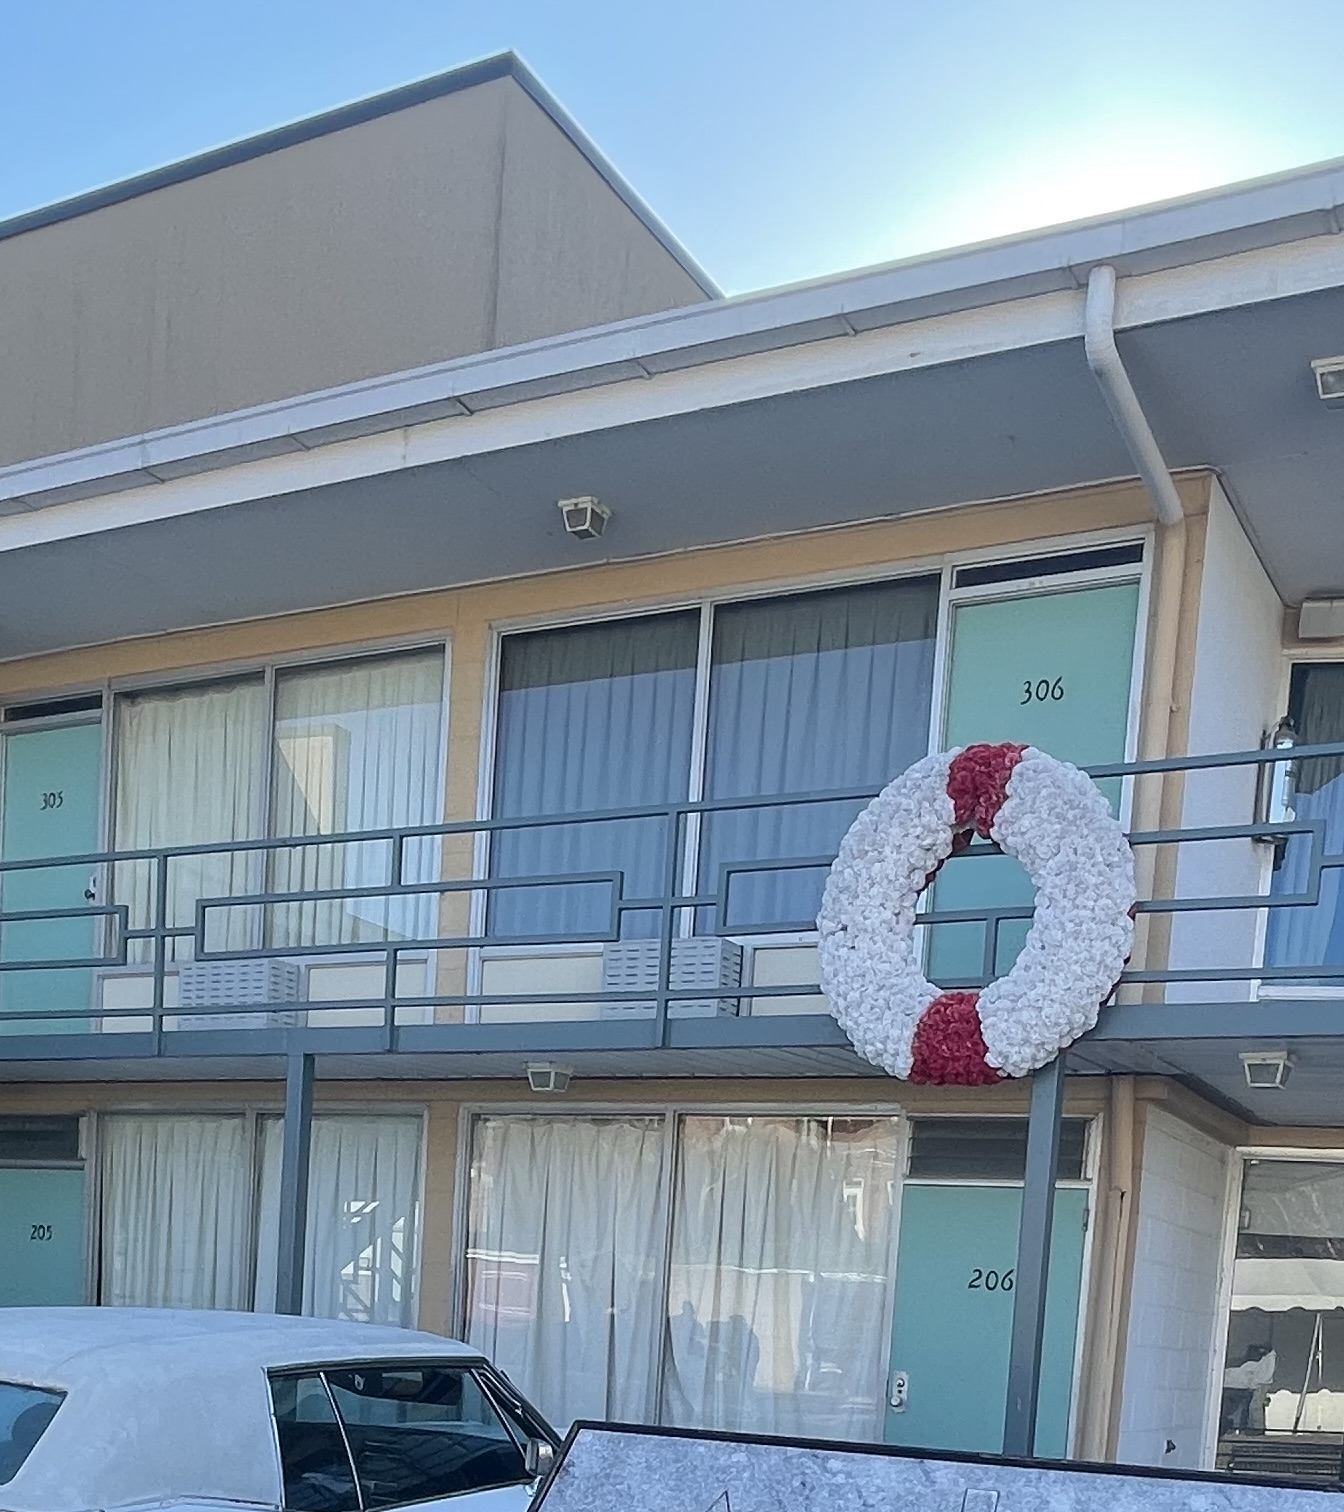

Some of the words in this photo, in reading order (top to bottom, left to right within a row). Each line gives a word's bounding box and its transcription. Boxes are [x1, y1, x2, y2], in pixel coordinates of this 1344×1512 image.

[1020, 676, 1064, 705] 306
[40, 791, 64, 810] 305
[30, 1224, 53, 1240] 205
[968, 1268, 1015, 1291] 206
